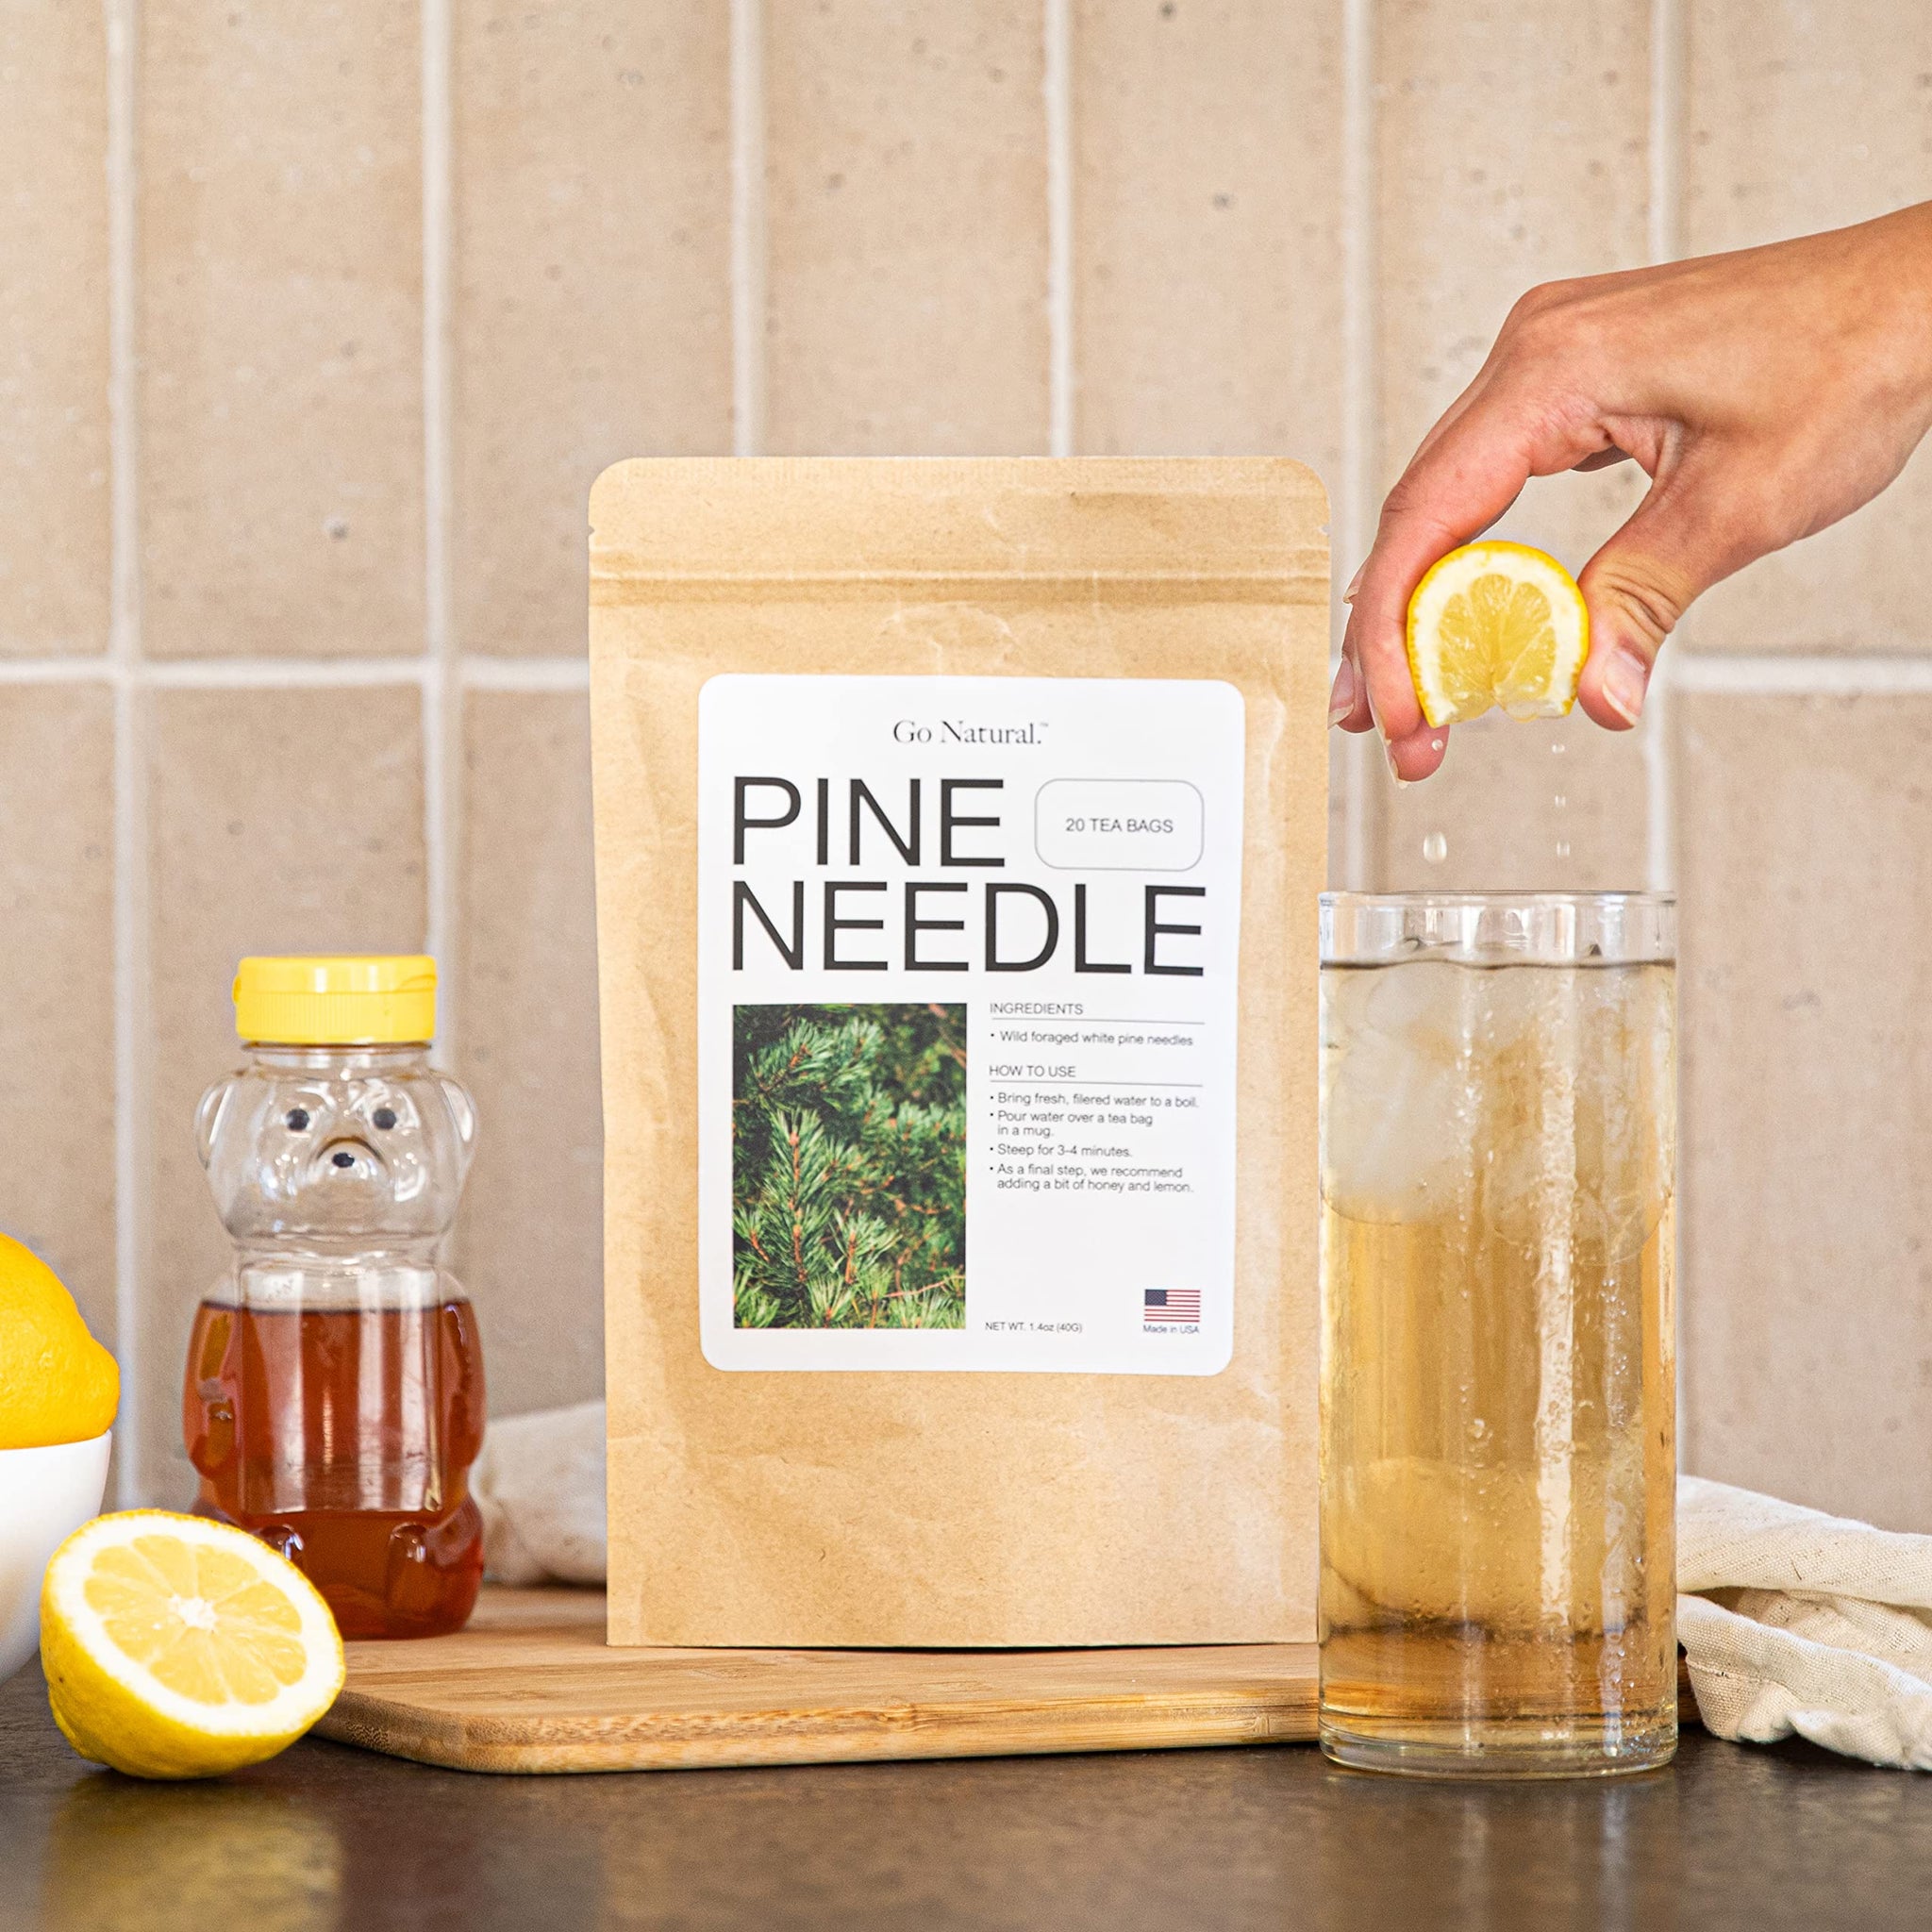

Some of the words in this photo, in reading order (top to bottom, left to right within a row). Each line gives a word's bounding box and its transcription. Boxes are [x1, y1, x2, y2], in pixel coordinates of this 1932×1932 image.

[892, 720, 932, 743] Go
[733, 775, 1007, 868] PINE
[1065, 817, 1086, 832] 20
[1090, 818, 1123, 832] TEA
[1126, 818, 1174, 834] BAGS
[732, 879, 1207, 977] NEEDLE
[990, 1002, 1084, 1016] INGREDIENTS
[1000, 1031, 1028, 1042] Wild
[1031, 1031, 1079, 1046] foraged
[1082, 1033, 1116, 1044] white
[1118, 1035, 1144, 1046] pine
[1147, 1034, 1194, 1047] needles
[989, 1064, 1024, 1077] HOW
[1026, 1065, 1045, 1077] TO
[1048, 1065, 1076, 1078] USE
[997, 1092, 1032, 1107] Bring
[1034, 1092, 1070, 1106] fresh,
[1114, 1095, 1147, 1108] water
[1150, 1095, 1162, 1108] to
[1164, 1098, 1172, 1108] a
[1174, 1096, 1200, 1108] boil.
[997, 1109, 1027, 1123] Pour
[1031, 1111, 1064, 1124] water
[1067, 1113, 1094, 1124] over
[1097, 1114, 1106, 1124] a
[1108, 1112, 1127, 1124] tea
[1130, 1113, 1154, 1127] bag
[997, 1124, 1009, 1136] in
[1011, 1126, 1021, 1137] a
[1023, 1126, 1055, 1138] mug.
[997, 1142, 1035, 1158] Steep
[1037, 1142, 1055, 1157] for
[1081, 1144, 1133, 1158] minutes.
[997, 1163, 1014, 1175] As
[1016, 1165, 1025, 1176] a
[1027, 1163, 1055, 1176] final
[1057, 1165, 1088, 1178] step,
[1090, 1168, 1108, 1177] we
[1110, 1166, 1184, 1179] recommend
[996, 1177, 1041, 1192] adding
[1042, 1179, 1052, 1191] a
[1054, 1178, 1071, 1191] bit
[1072, 1178, 1086, 1191] of
[1087, 1178, 1125, 1194] honey
[1127, 1179, 1151, 1192] and
[1153, 1180, 1195, 1194] lemon.
[984, 1321, 1007, 1331] NET
[1056, 1323, 1084, 1334] (40G)
[1142, 1324, 1169, 1334] Made
[1169, 1325, 1178, 1334] in
[1179, 1324, 1201, 1335] USA
